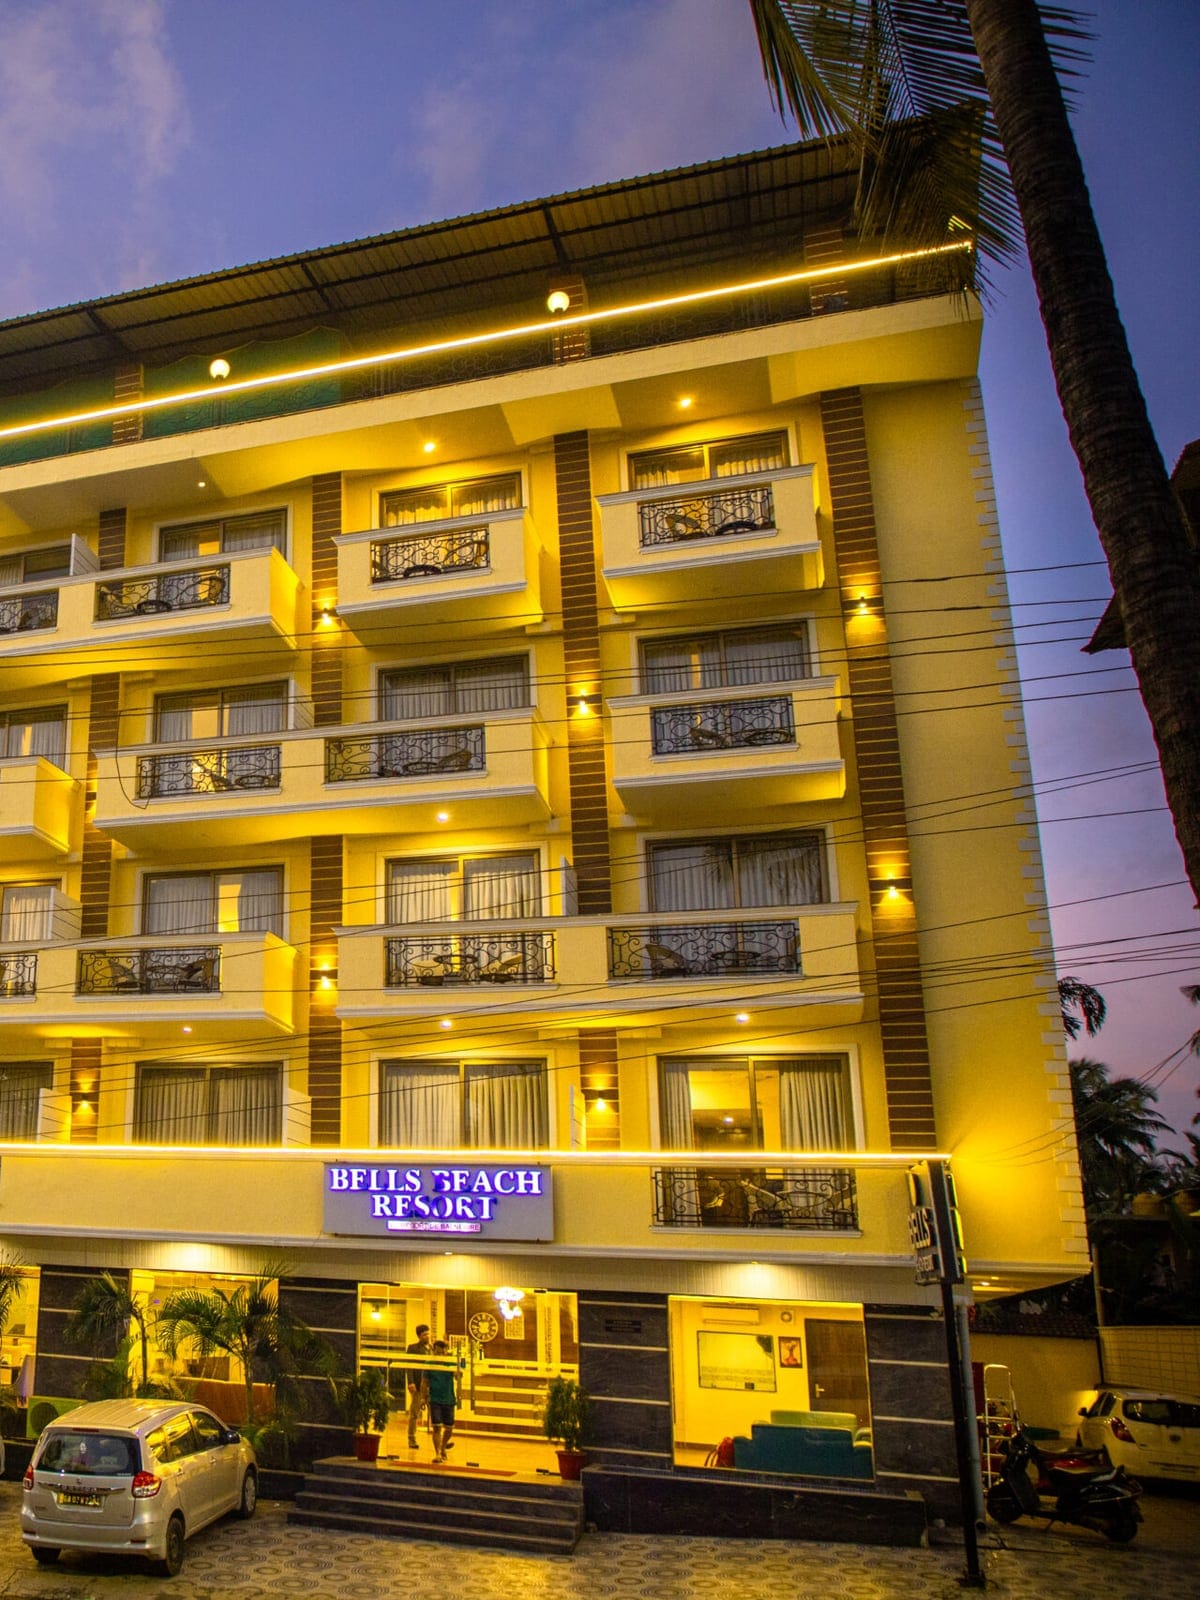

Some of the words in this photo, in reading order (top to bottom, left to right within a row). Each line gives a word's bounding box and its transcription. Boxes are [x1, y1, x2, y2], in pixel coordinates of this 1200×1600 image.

[329, 1168, 421, 1191] BELLS
[432, 1170, 542, 1194] BEACH
[372, 1195, 497, 1219] RESORT
